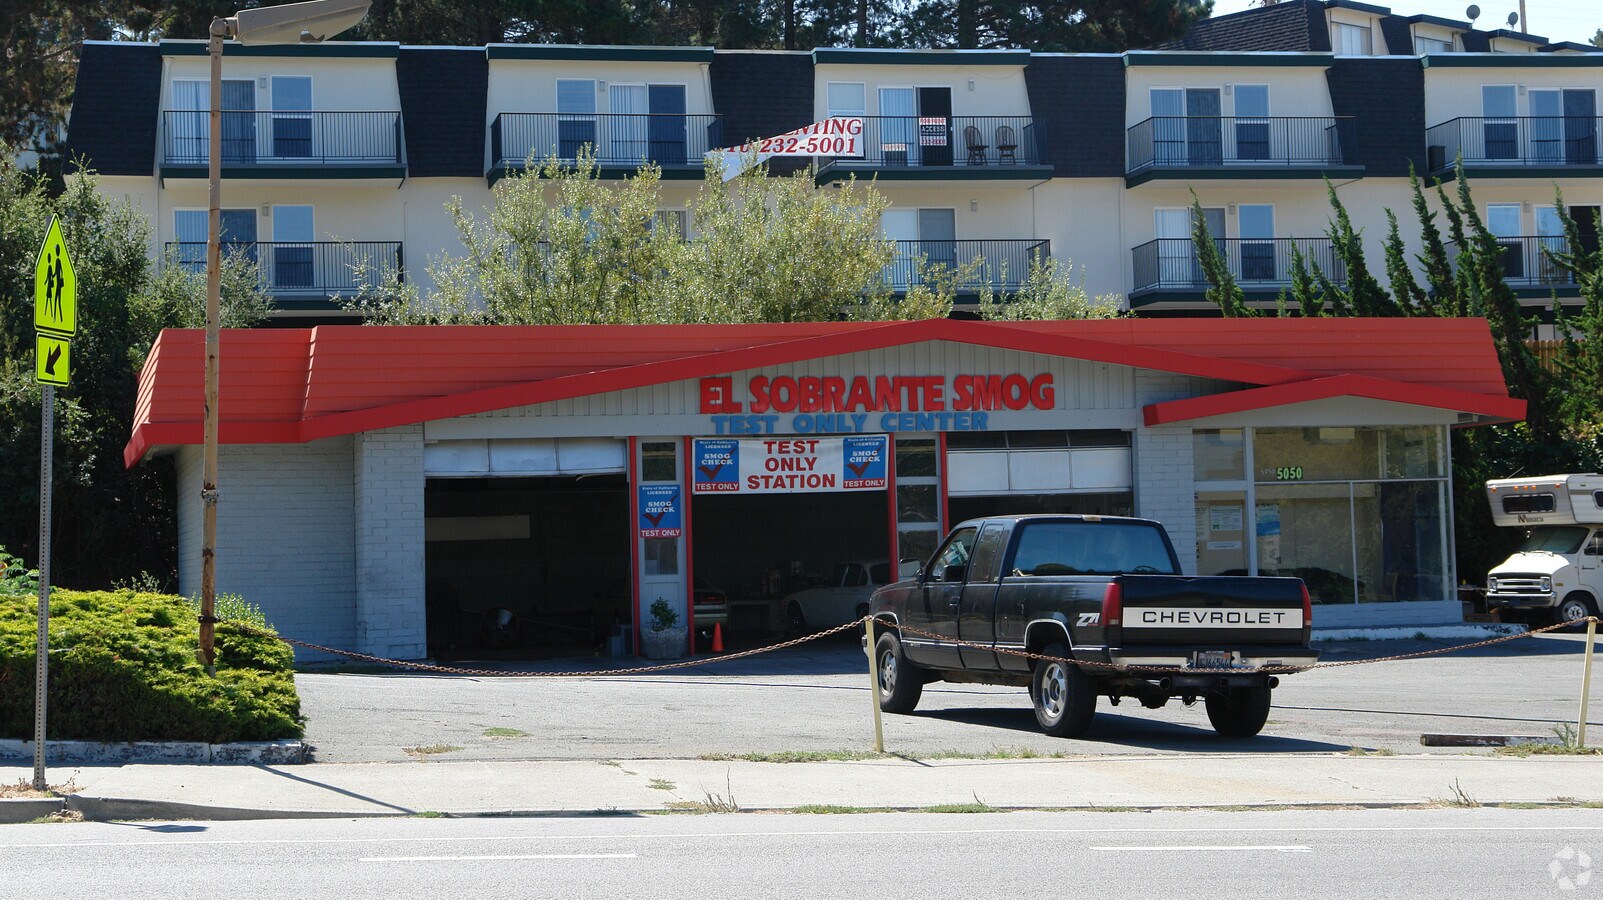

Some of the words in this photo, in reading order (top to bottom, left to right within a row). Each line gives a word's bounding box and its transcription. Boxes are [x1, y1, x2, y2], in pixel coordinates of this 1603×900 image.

[921, 125, 945, 133] ACCESS
[700, 377, 742, 414] EL
[750, 375, 945, 413] SOBRANTE
[953, 373, 1055, 411] SMOG
[711, 415, 779, 434] TEST
[793, 413, 868, 433] ONLY
[881, 411, 989, 431] CENTER
[763, 440, 820, 455] TEST
[764, 457, 818, 472] ONLY
[1277, 467, 1302, 480] 5050
[747, 474, 836, 490] STATION
[1076, 612, 1100, 626] Z71
[1142, 611, 1286, 624] CHEVROLET
